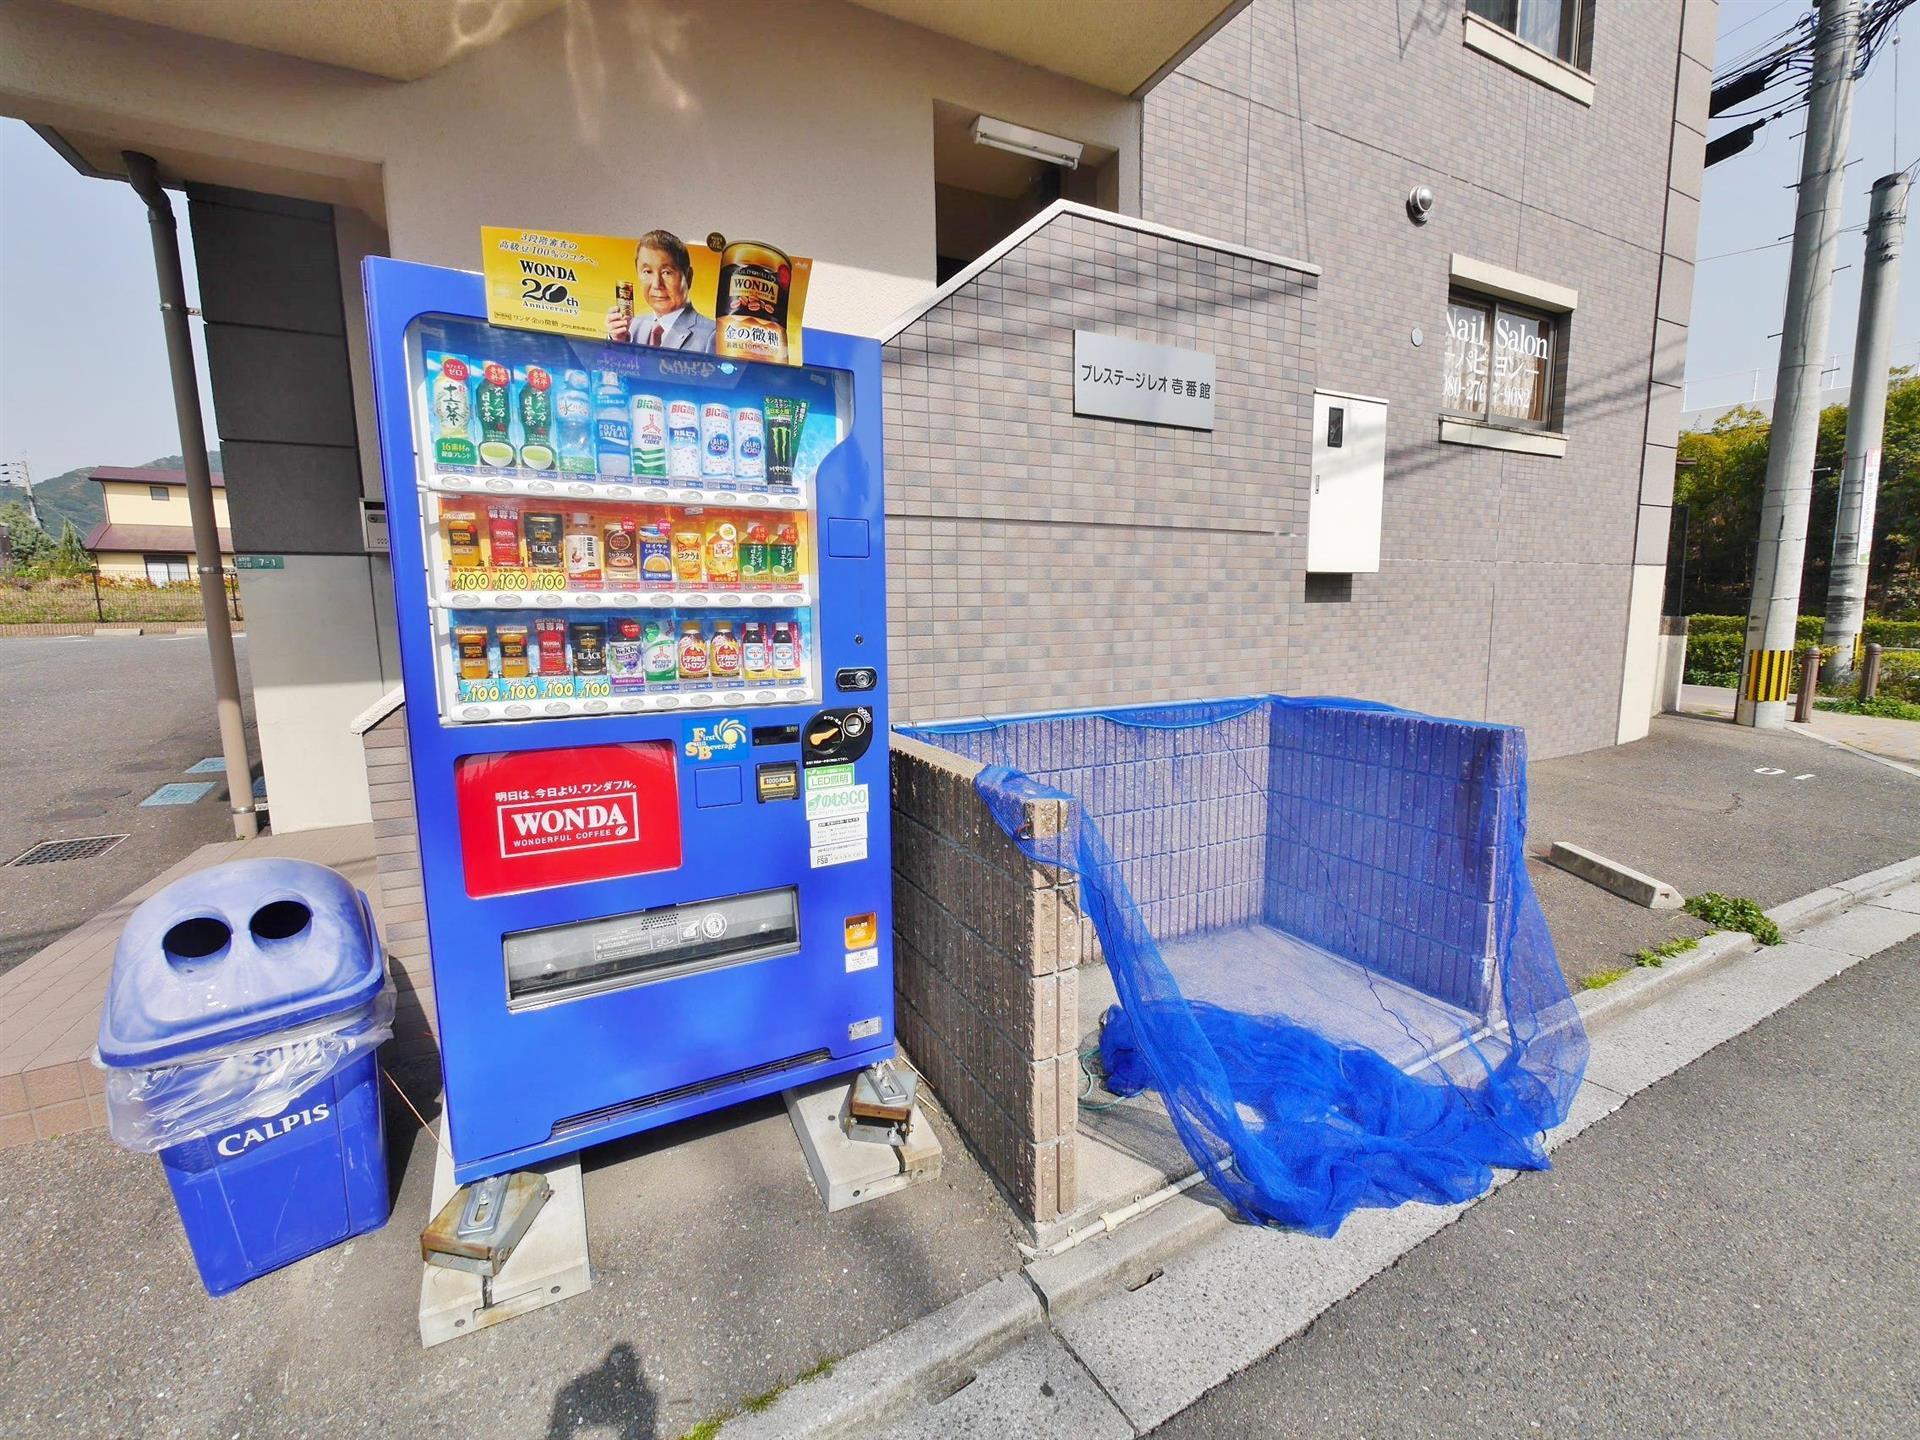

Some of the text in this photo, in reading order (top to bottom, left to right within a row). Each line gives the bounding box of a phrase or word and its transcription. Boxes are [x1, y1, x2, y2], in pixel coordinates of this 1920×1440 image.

[520, 260, 577, 281] WONDA
[522, 278, 579, 307] 20th
[734, 278, 775, 296] WONDA
[522, 301, 578, 315] Anniversary
[726, 325, 779, 347] 金の微糖
[1446, 307, 1549, 360] Nail Salon
[1081, 364, 1212, 400] プレステージレオ壱番館
[671, 404, 687, 414] BIG
[705, 408, 721, 418] BIG
[739, 412, 754, 421] BIG
[531, 545, 558, 553] BLACK
[259, 558, 276, 567] 7-1
[459, 573, 489, 590] 100
[499, 573, 528, 590] 100
[540, 574, 567, 590] 100
[577, 651, 602, 660] BLACK
[471, 685, 500, 701] 100
[509, 683, 538, 700] 100
[547, 682, 574, 697] 100
[584, 682, 610, 697] 100
[692, 727, 717, 742] First
[811, 774, 849, 787] LED照明
[495, 780, 638, 802] 明日は、今日より、ワンダフル。
[511, 803, 628, 837] WONDA
[513, 829, 612, 848] WONDERFUL COFFEE
[217, 1103, 330, 1156] CALPIS
